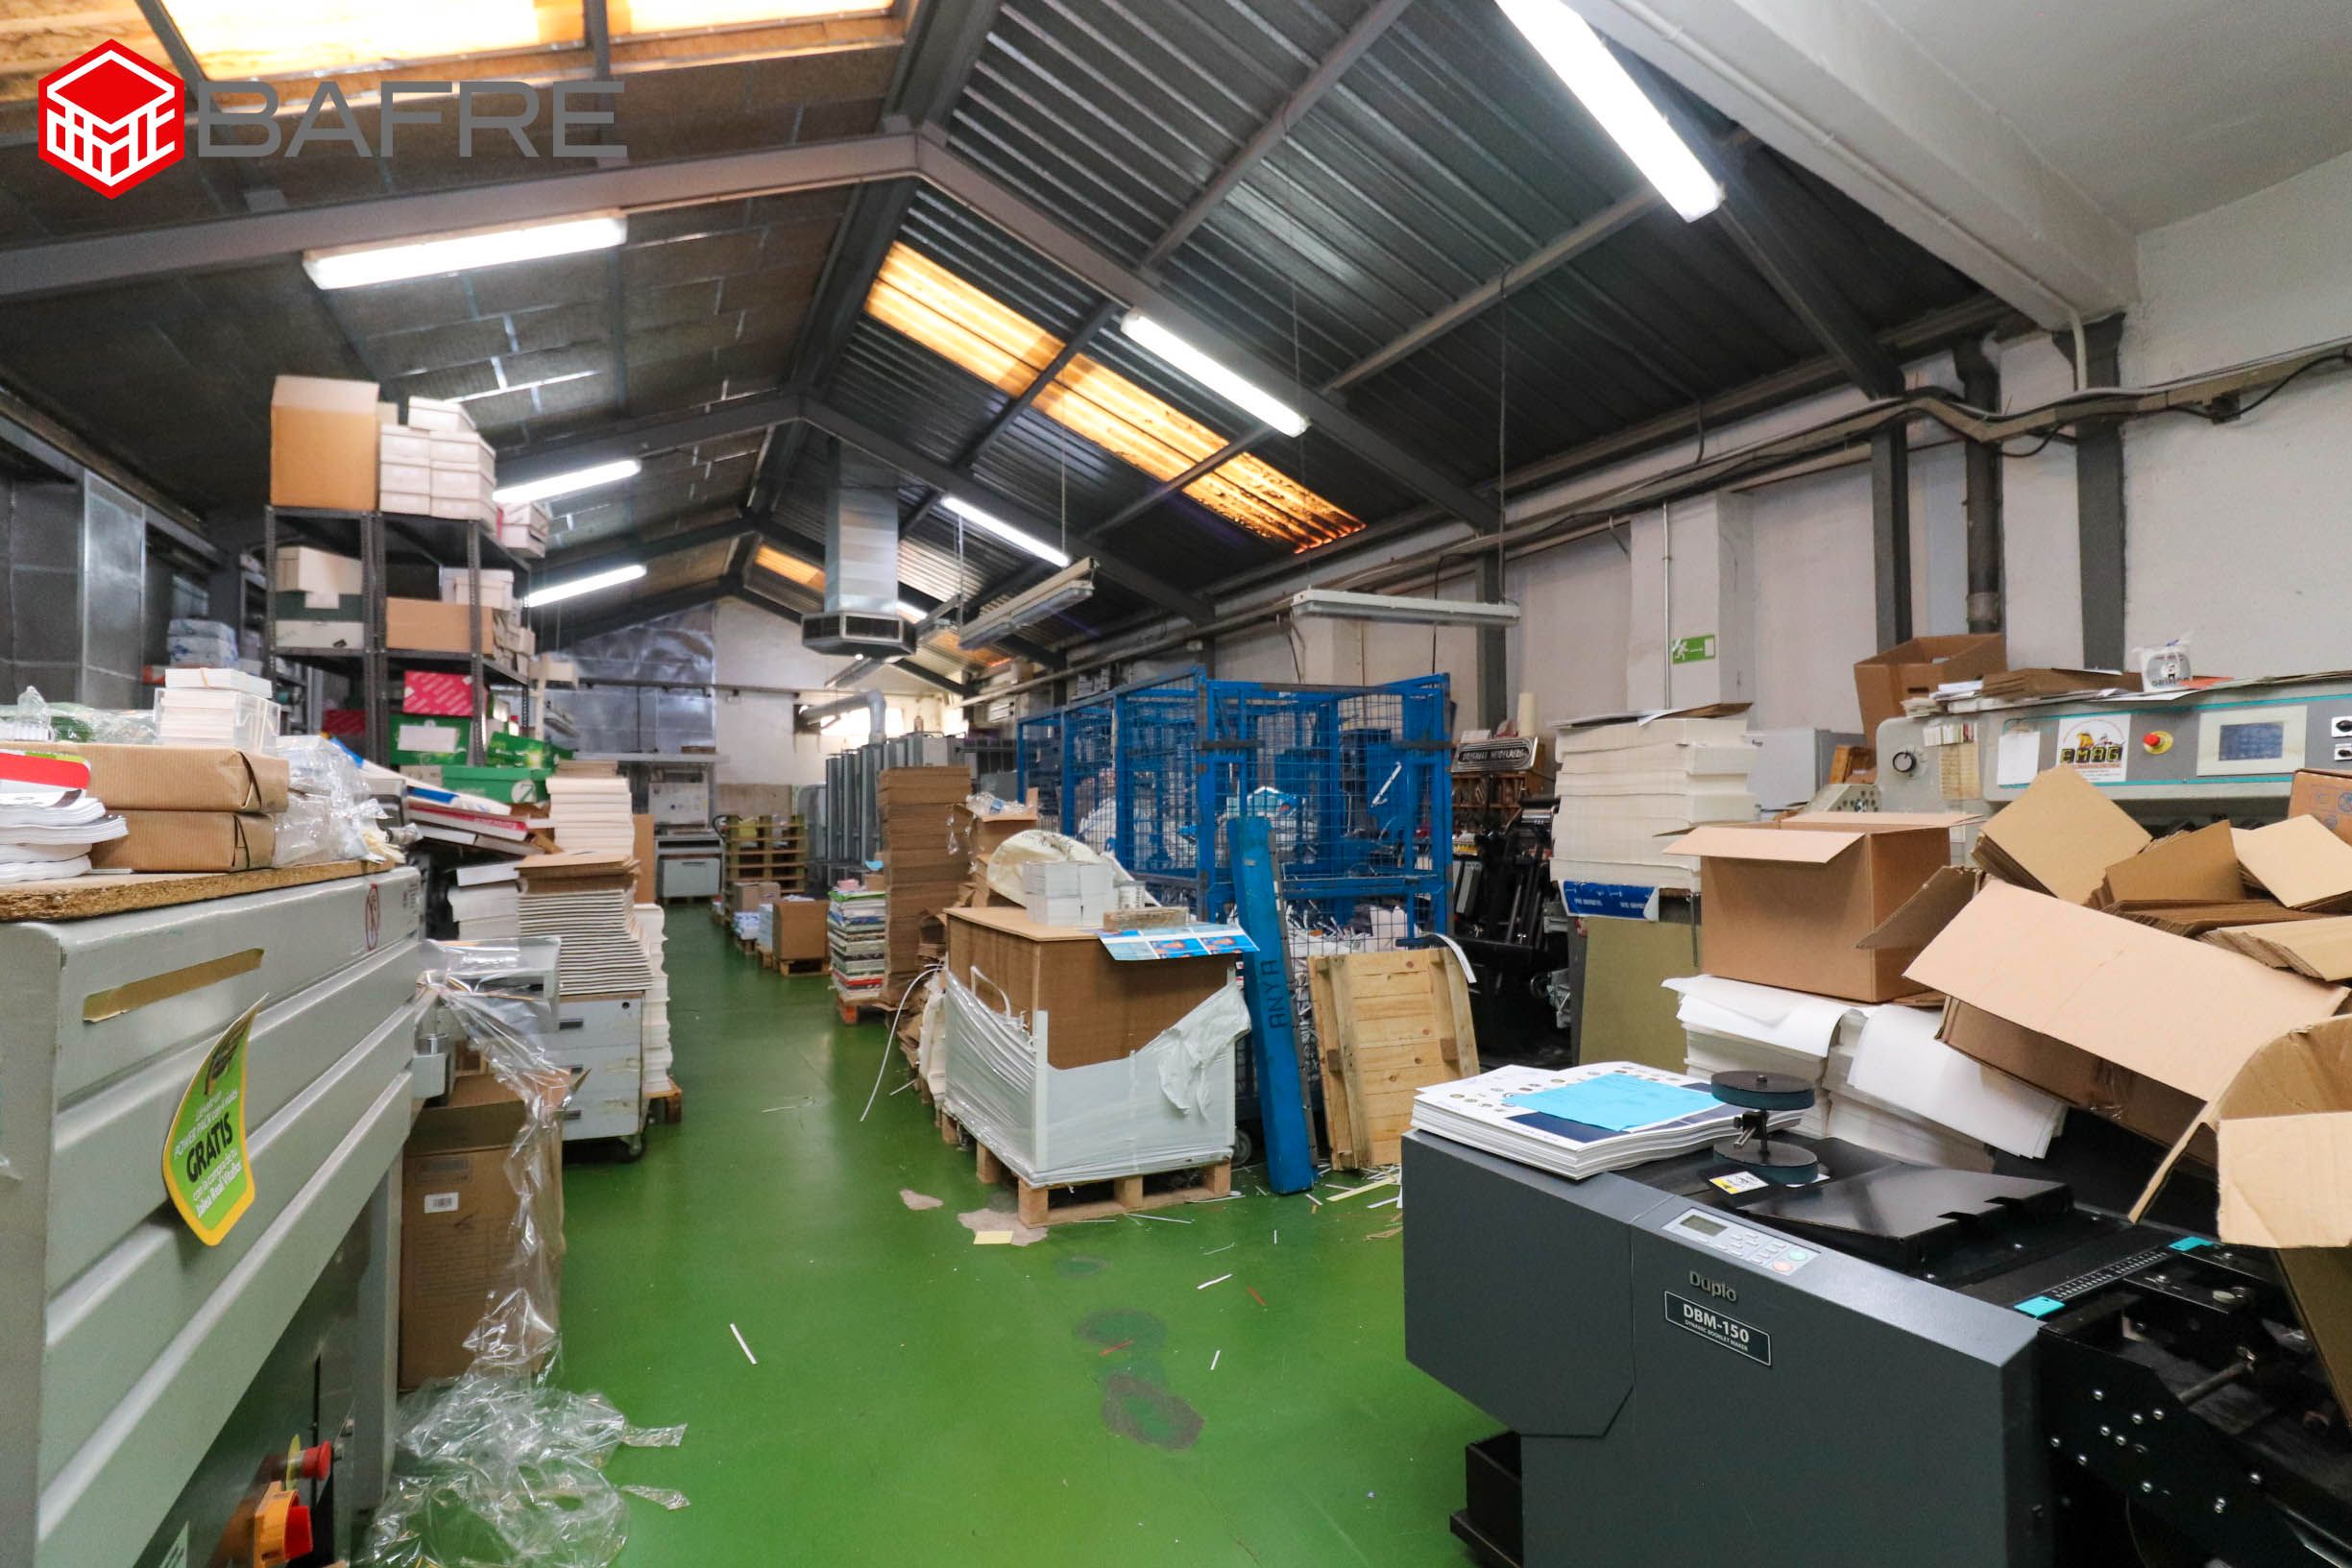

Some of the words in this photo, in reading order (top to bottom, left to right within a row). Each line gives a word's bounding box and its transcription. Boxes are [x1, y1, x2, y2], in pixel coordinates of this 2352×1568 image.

[186, 1112, 232, 1183] GRATIS
[1689, 1270, 1737, 1302] Duplo
[1683, 1303, 1750, 1343] DBM-150
